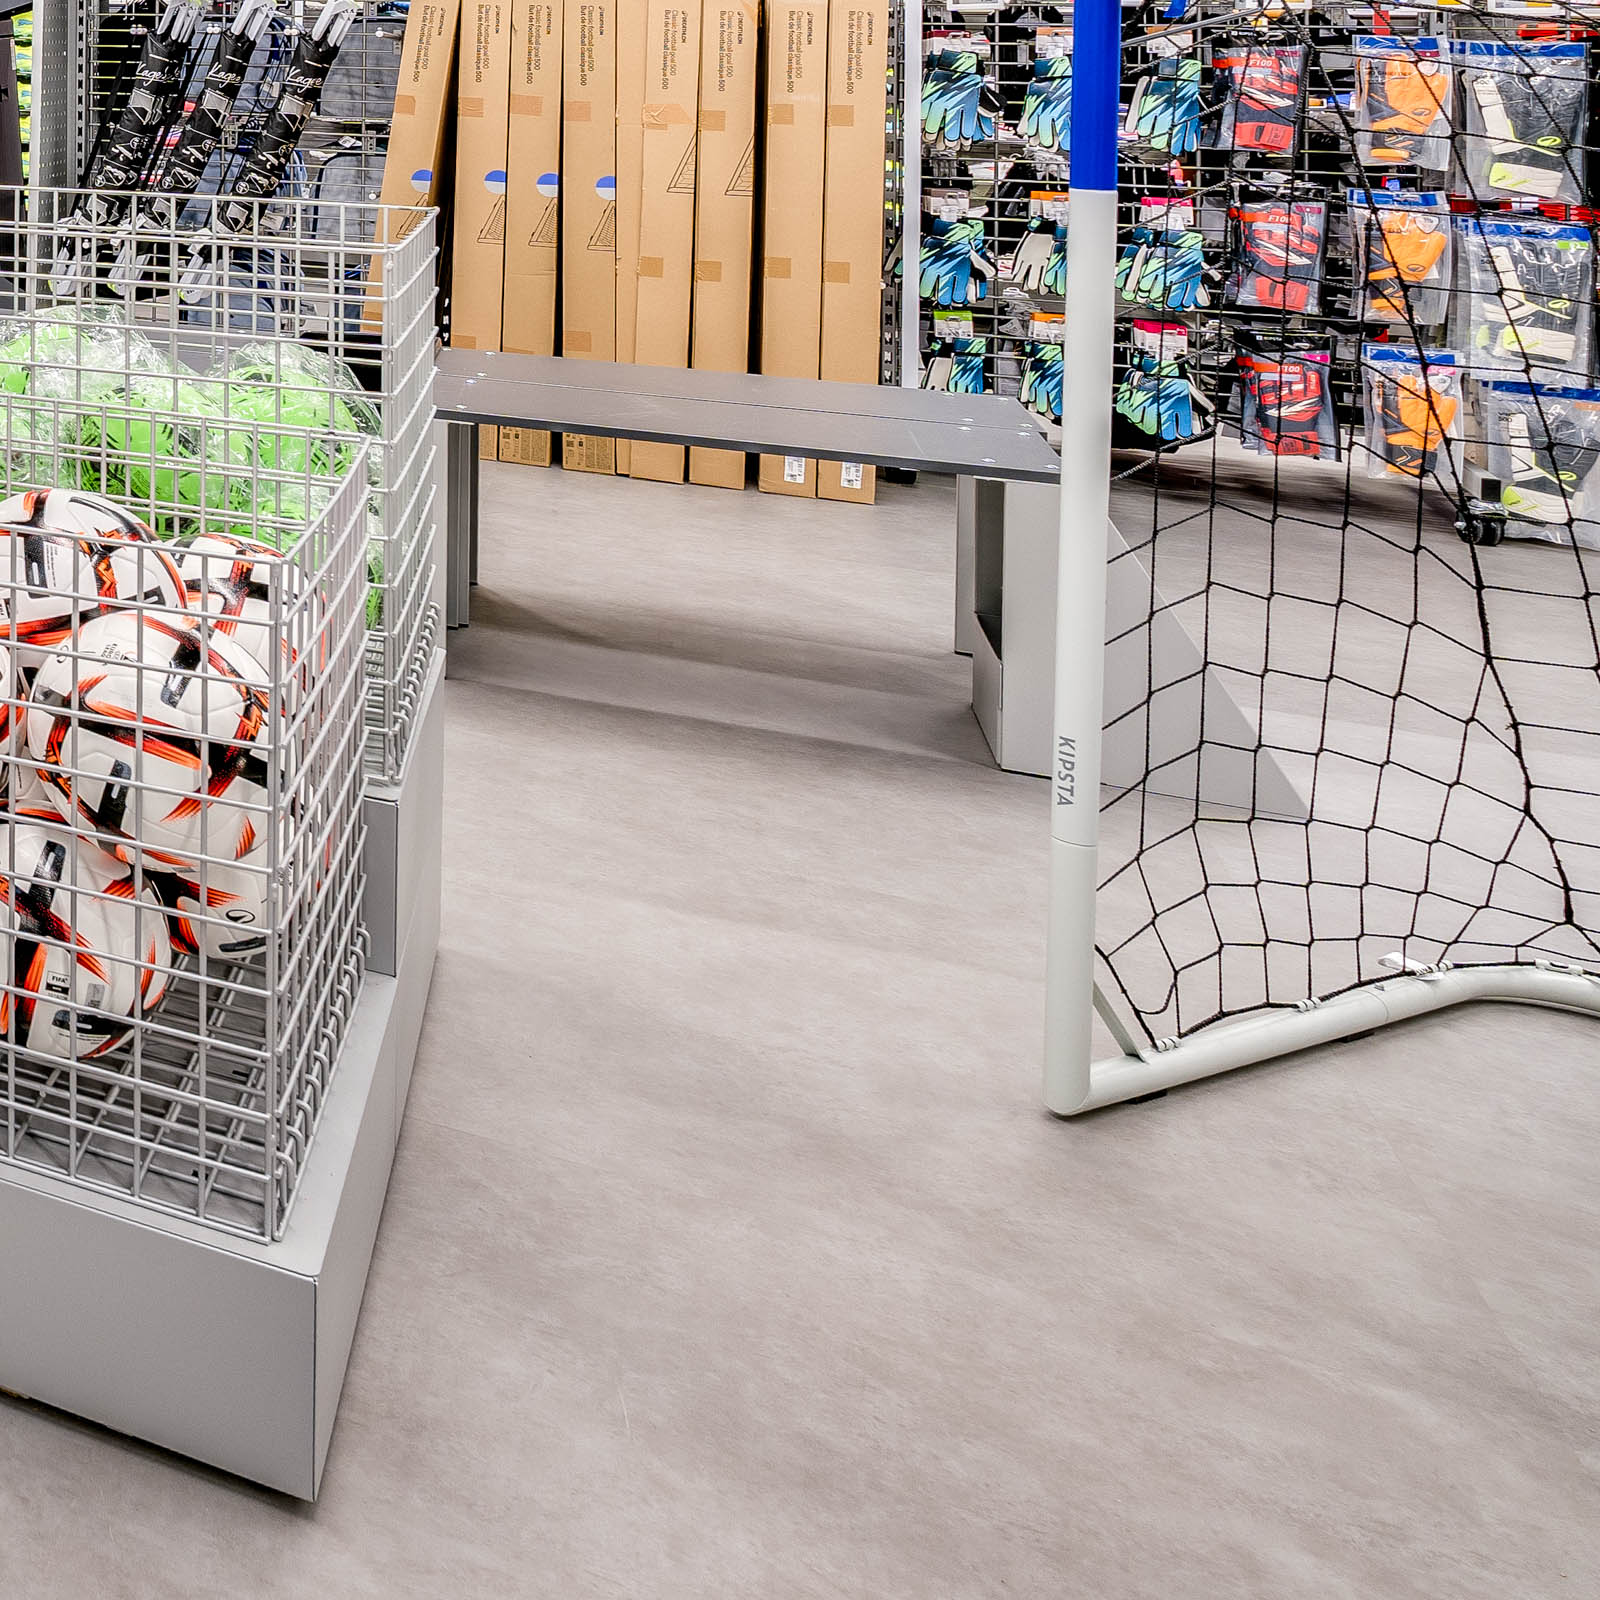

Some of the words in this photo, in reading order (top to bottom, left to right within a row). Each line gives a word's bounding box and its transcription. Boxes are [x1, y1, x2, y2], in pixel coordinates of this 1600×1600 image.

[789, 21, 795, 29] de
[848, 11, 856, 21] But
[856, 11, 864, 31] Classic
[419, 24, 427, 44] football
[424, 26, 433, 45] football
[848, 22, 855, 30] de
[670, 30, 678, 51] football
[414, 45, 423, 70] classique
[422, 46, 430, 58] goal
[526, 45, 534, 71] classique
[533, 46, 541, 58] goal
[579, 46, 587, 73] classique
[586, 47, 594, 59] goal
[669, 52, 677, 64] goal
[725, 53, 733, 64] goal
[718, 52, 726, 79] classique
[846, 54, 854, 81] classique
[1057, 735, 1076, 806] KIPSTA
